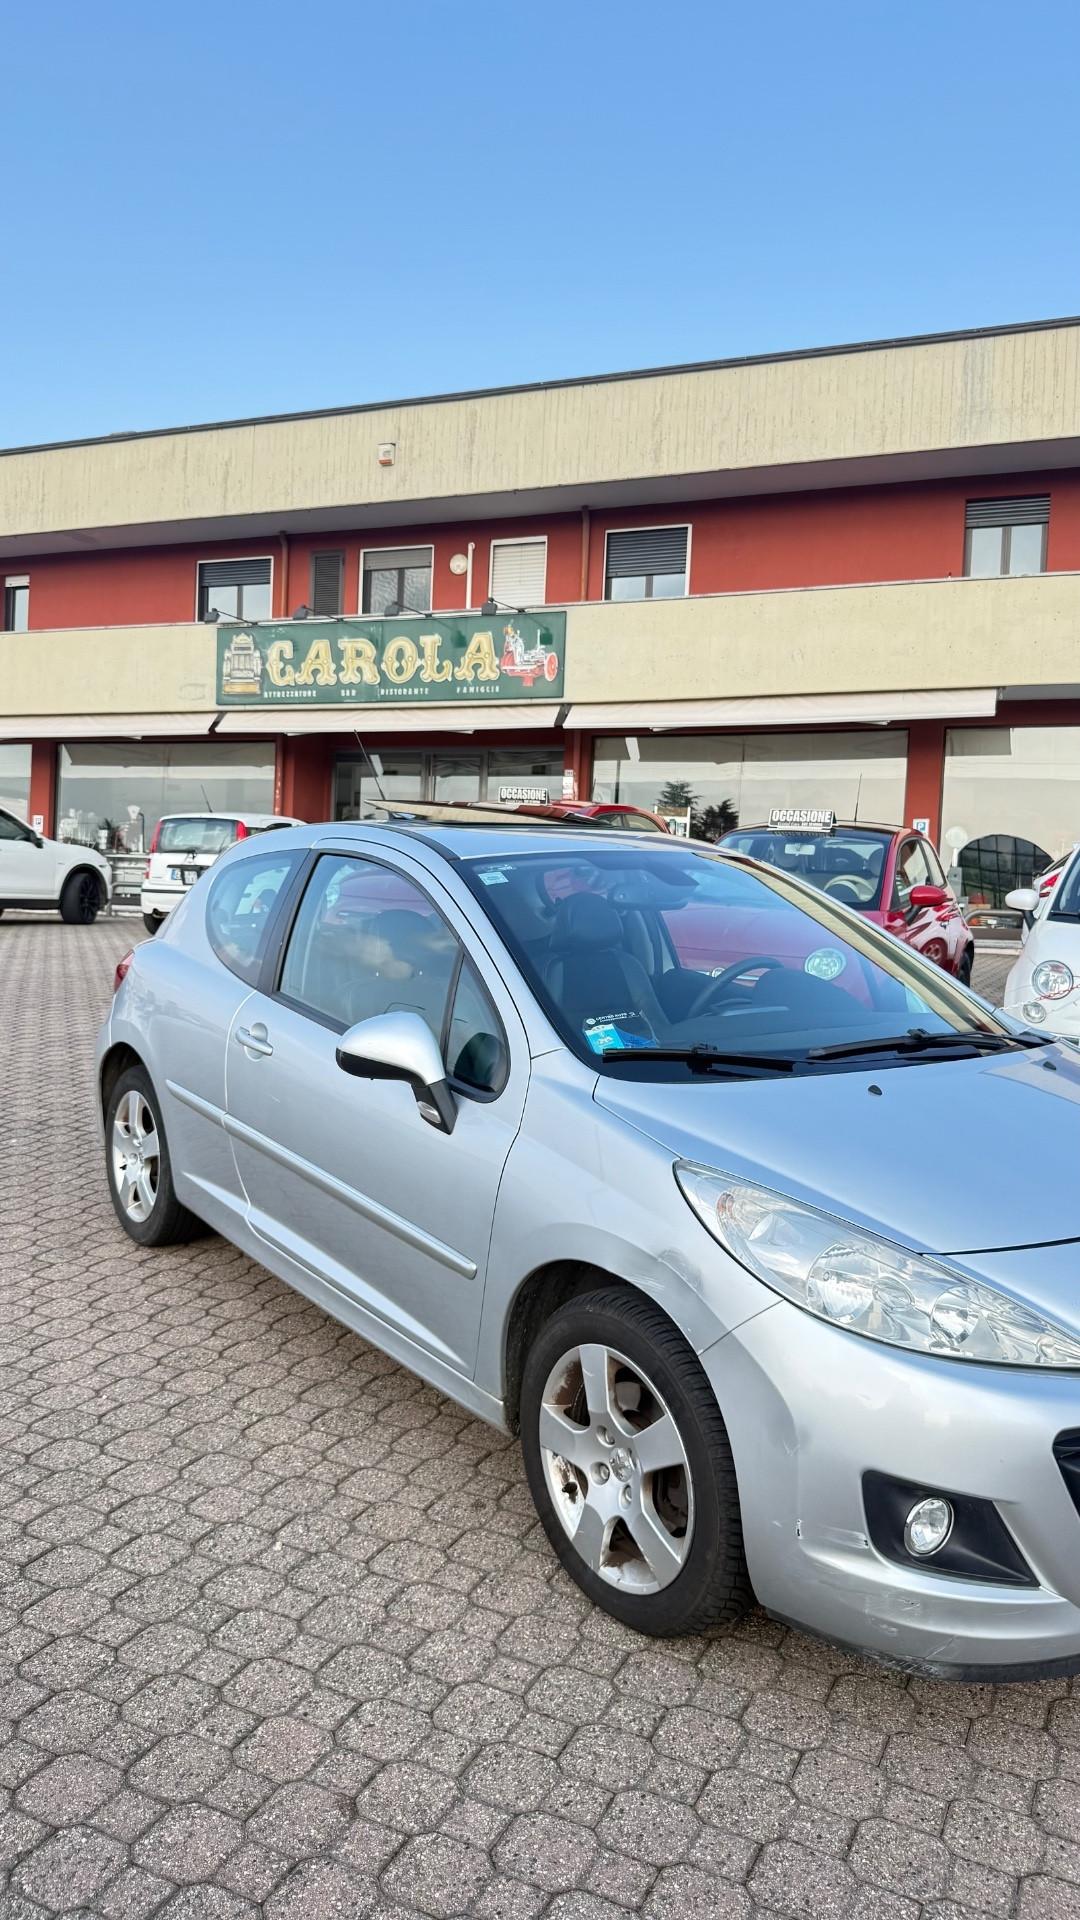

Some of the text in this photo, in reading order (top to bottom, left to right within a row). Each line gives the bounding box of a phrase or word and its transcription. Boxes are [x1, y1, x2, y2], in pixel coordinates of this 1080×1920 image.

[266, 631, 500, 686] CAROLA
[380, 687, 430, 696] RISTORANTE
[456, 685, 500, 694] FAMIGLIA
[501, 788, 546, 800] OCCASIONE
[771, 810, 831, 822] OCCASIONE
